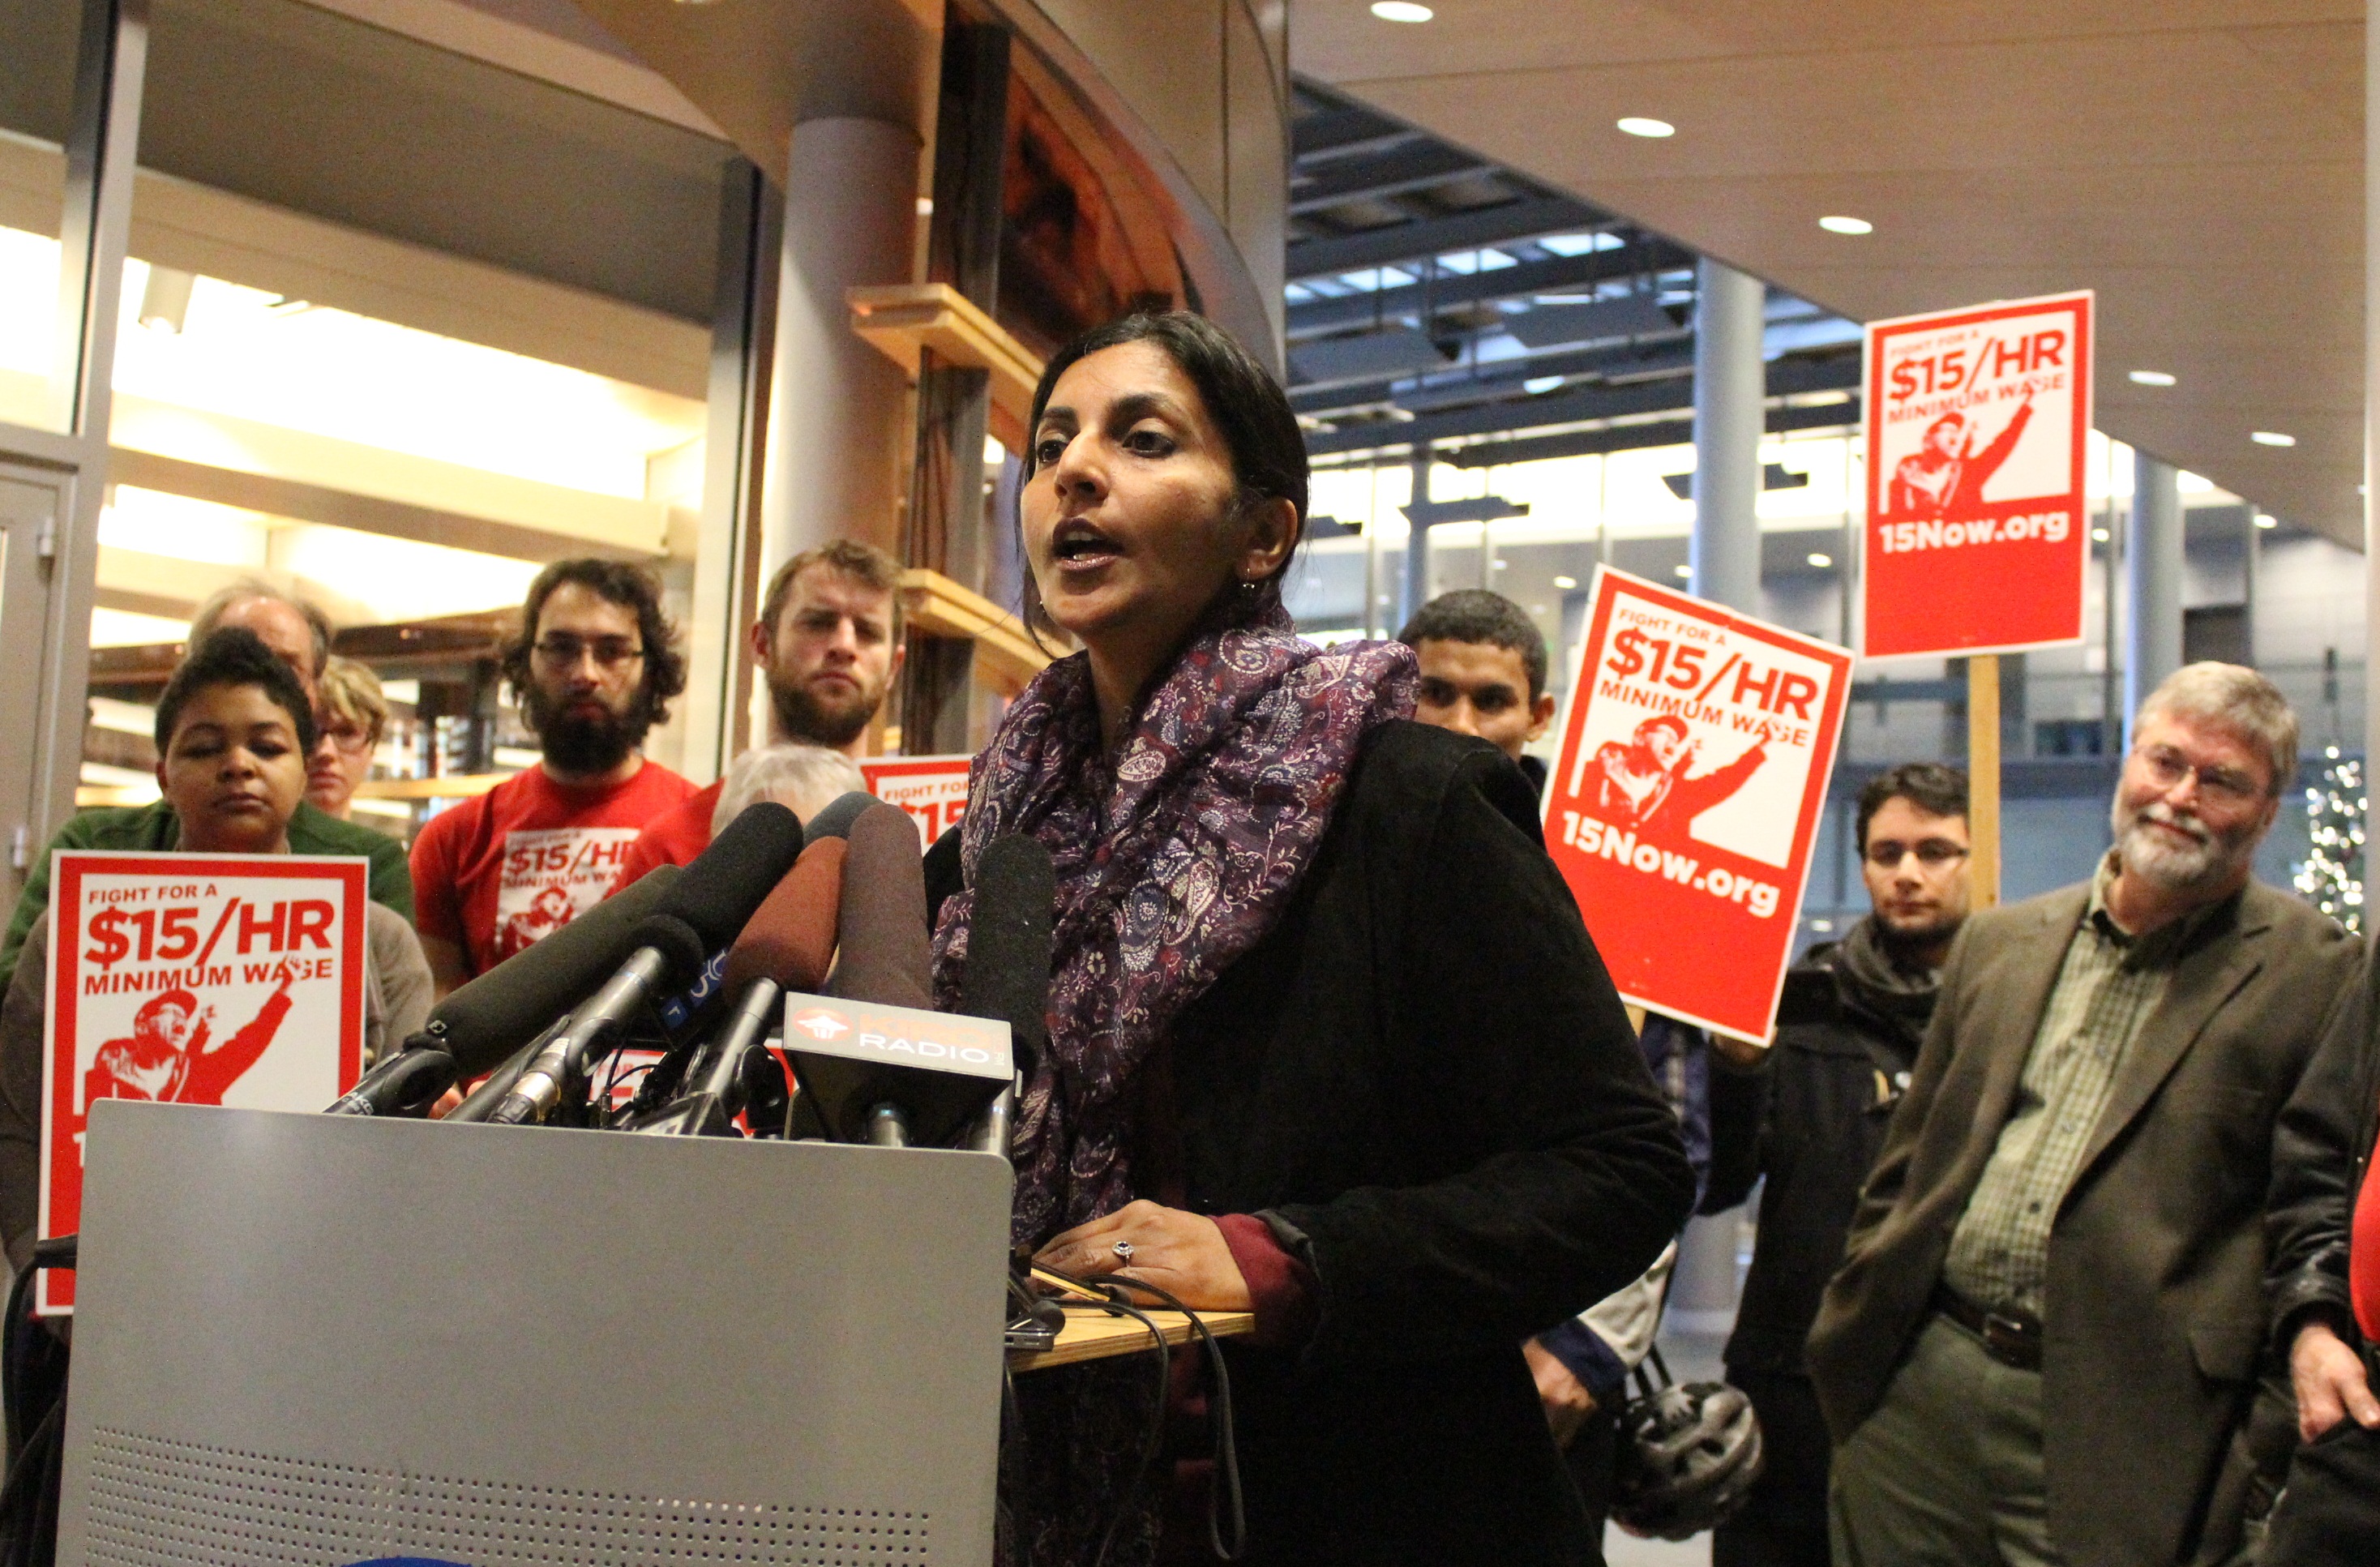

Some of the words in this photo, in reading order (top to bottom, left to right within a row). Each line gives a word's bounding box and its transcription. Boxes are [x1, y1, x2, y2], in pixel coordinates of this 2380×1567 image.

[1889, 330, 2065, 404] $15/HR
[1888, 389, 1989, 424] MINIMUM
[1878, 512, 2070, 554] 15Now.org
[1619, 609, 1672, 631] FIGHT
[1676, 623, 1710, 641] FOR
[1715, 635, 1726, 646] A
[1607, 627, 1818, 721] $15/HR
[1599, 679, 1723, 723] MINIMUM
[884, 785, 934, 800] FIGHT
[1563, 811, 1780, 918] 15Now.org
[88, 888, 151, 904] FIGHT
[157, 884, 198, 900] FOR
[205, 884, 218, 897] A
[84, 897, 335, 971] $15/HR
[84, 965, 232, 995] MINIMUM
[860, 1013, 991, 1048] KIRO
[860, 1034, 990, 1064] RADIO
